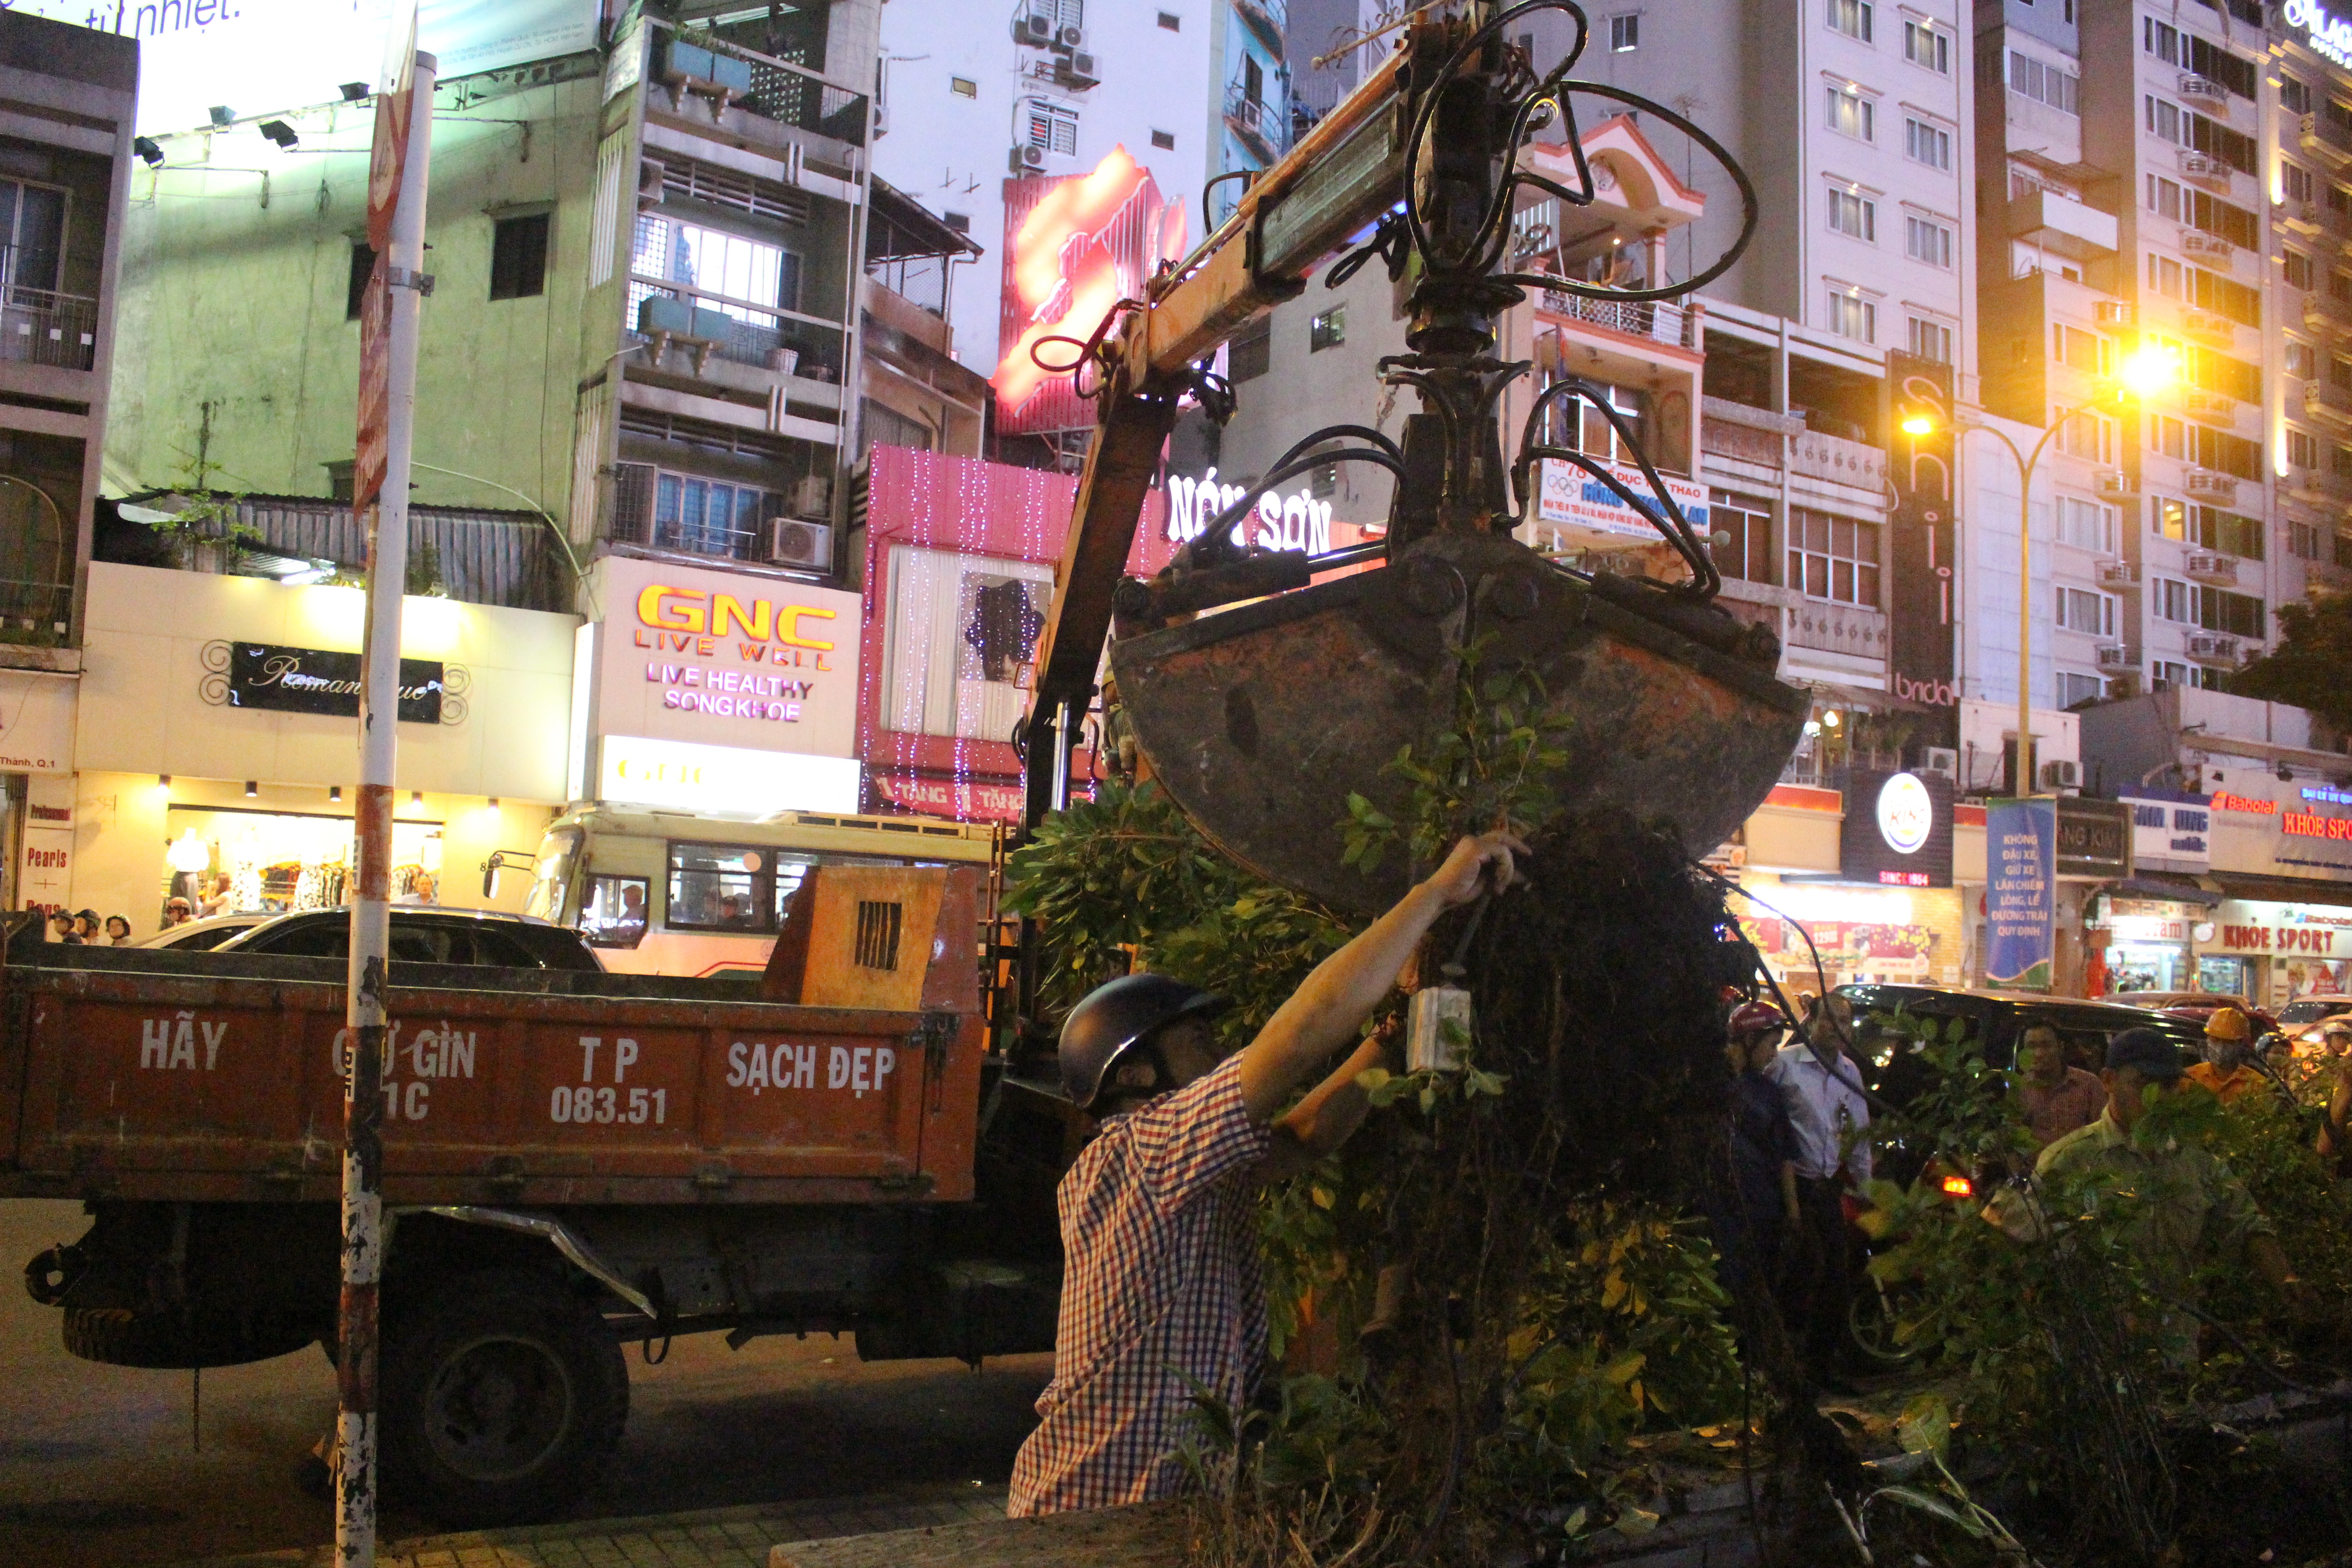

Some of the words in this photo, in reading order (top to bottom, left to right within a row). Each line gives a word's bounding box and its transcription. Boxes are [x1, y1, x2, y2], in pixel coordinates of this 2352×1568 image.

[1617, 472, 1641, 485] DỤC
[1670, 484, 1700, 498] THAO
[1257, 488, 1332, 556] SƠN
[637, 584, 836, 651] GNC
[635, 629, 715, 657] LIVE
[740, 642, 832, 671] WELL
[647, 662, 700, 687] LIVE
[707, 670, 813, 700] HEALTHY
[2283, 806, 2325, 837] KHỎE
[2004, 833, 2038, 845] KHÔNG
[28, 848, 67, 868] Pearls
[2023, 865, 2035, 875] XE
[1879, 871, 1907, 885] SINCE
[1907, 872, 1929, 886] 1954
[1997, 926, 2016, 936] QUY
[2224, 916, 2271, 950] KHỎE
[2277, 928, 2334, 952] SPORT
[140, 1010, 228, 1070] HÃY
[412, 1020, 476, 1078] GÌN
[726, 1042, 817, 1096] SẠCH
[827, 1045, 897, 1099] ĐẸP
[550, 1086, 666, 1124] 083.51
